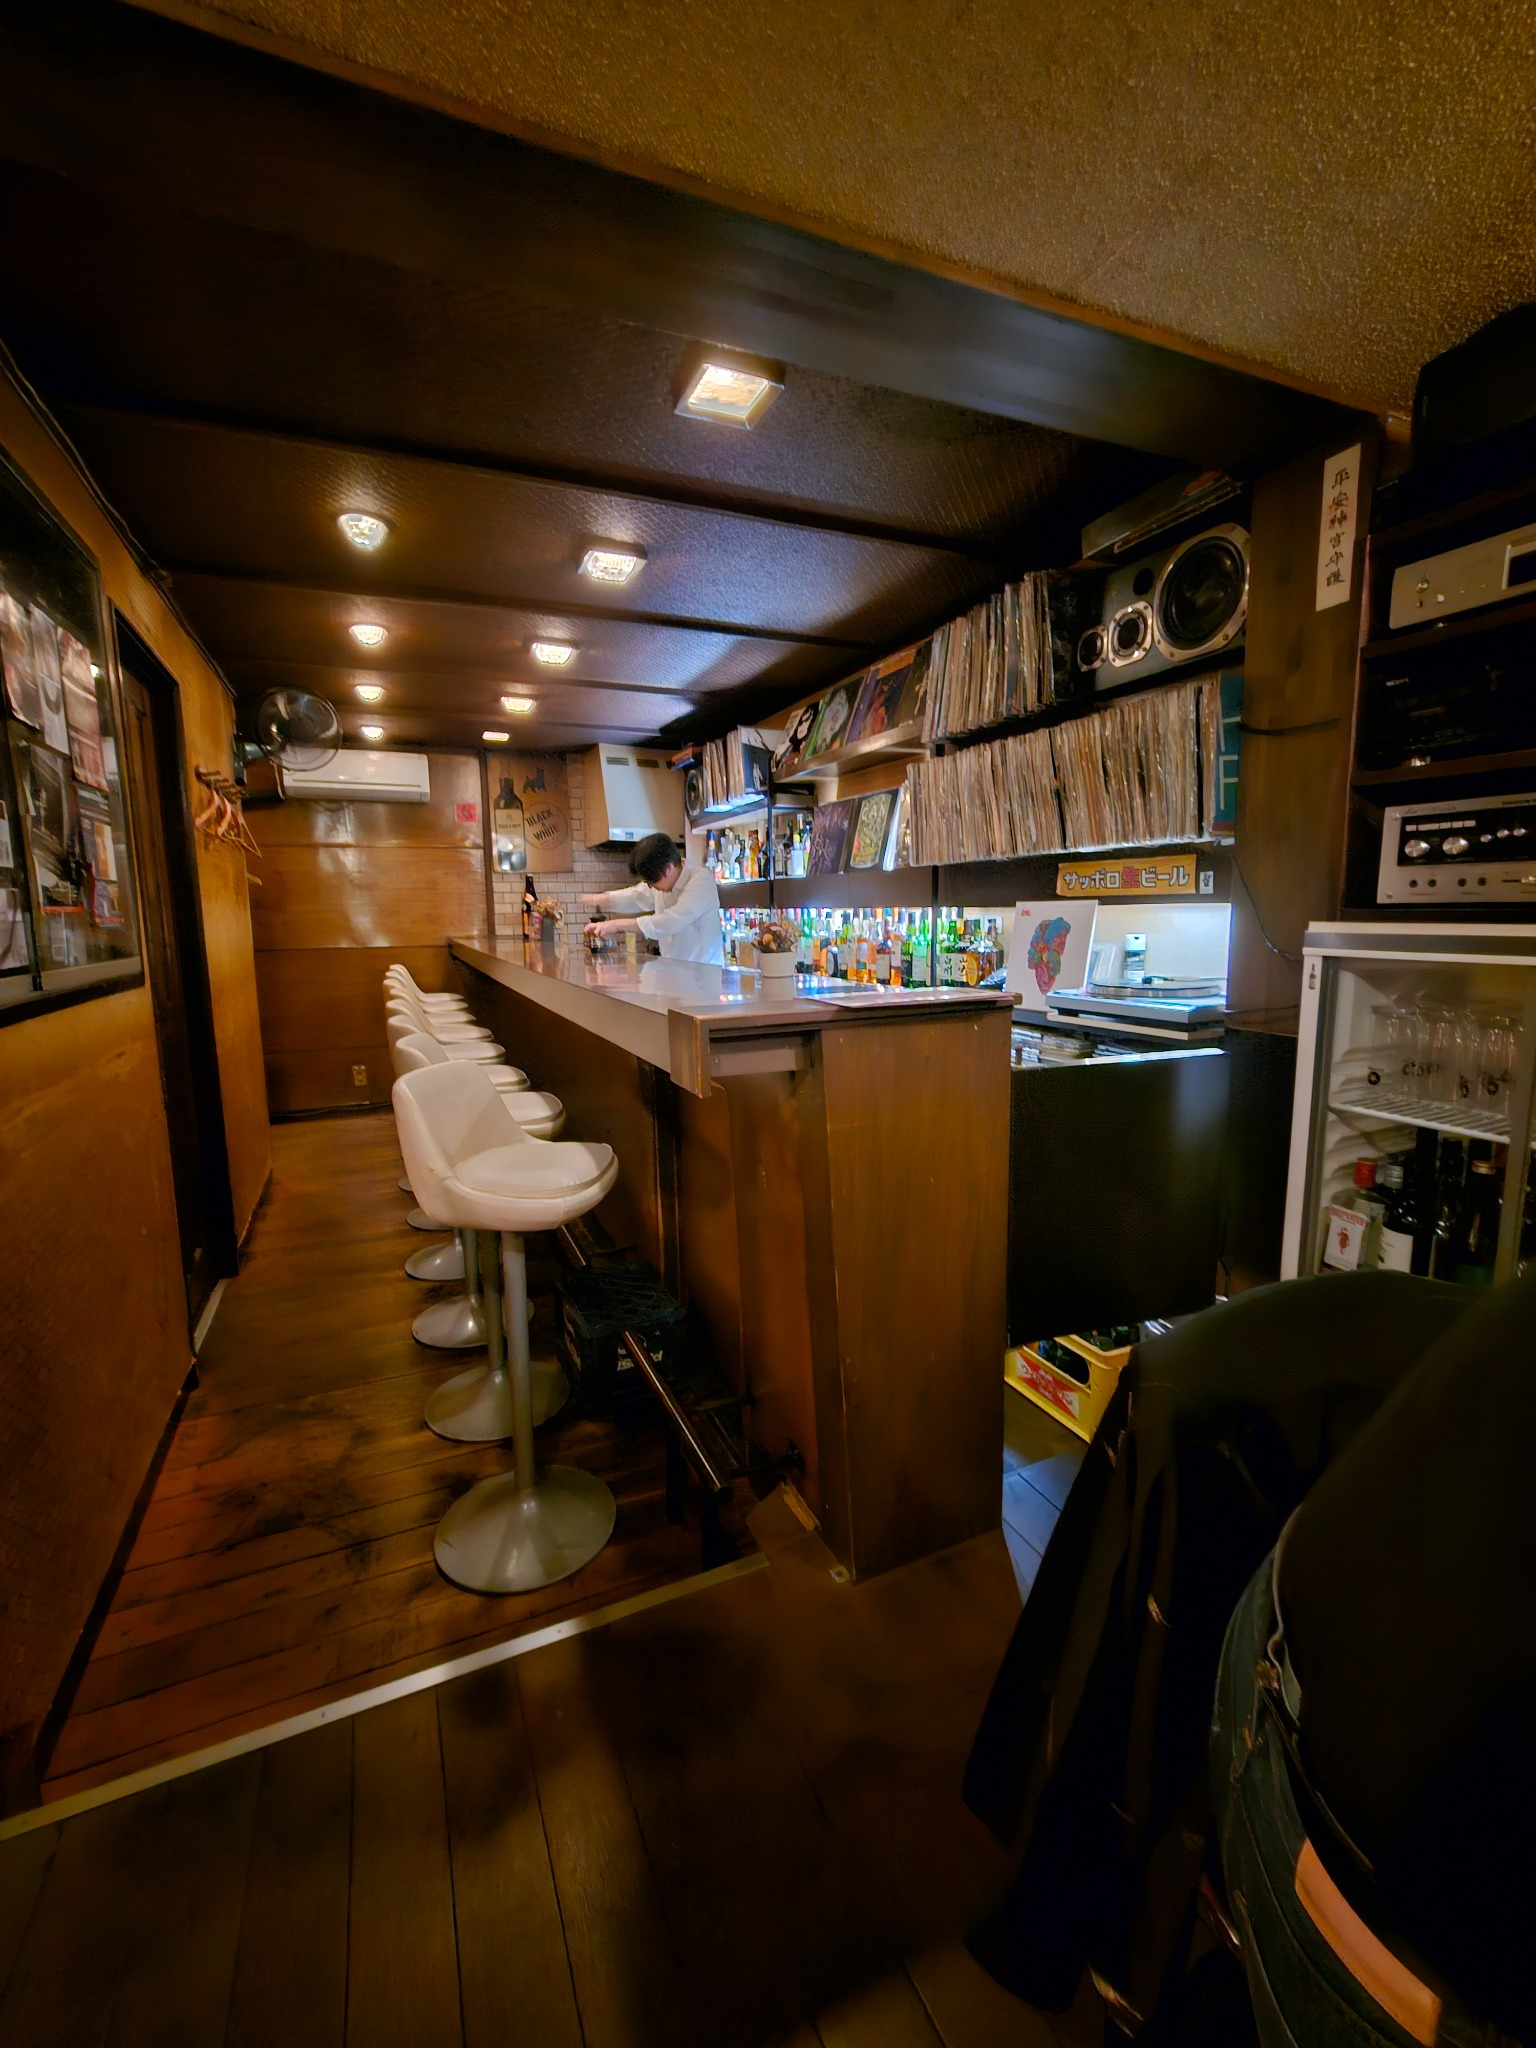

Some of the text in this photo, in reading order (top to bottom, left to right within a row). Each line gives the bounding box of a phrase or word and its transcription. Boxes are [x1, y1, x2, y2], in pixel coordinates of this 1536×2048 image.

[525, 807, 553, 827] BLACK
[862, 804, 887, 822] CAN
[533, 824, 559, 841] WHITE
[1063, 865, 1189, 891] サッポロ生ビール
